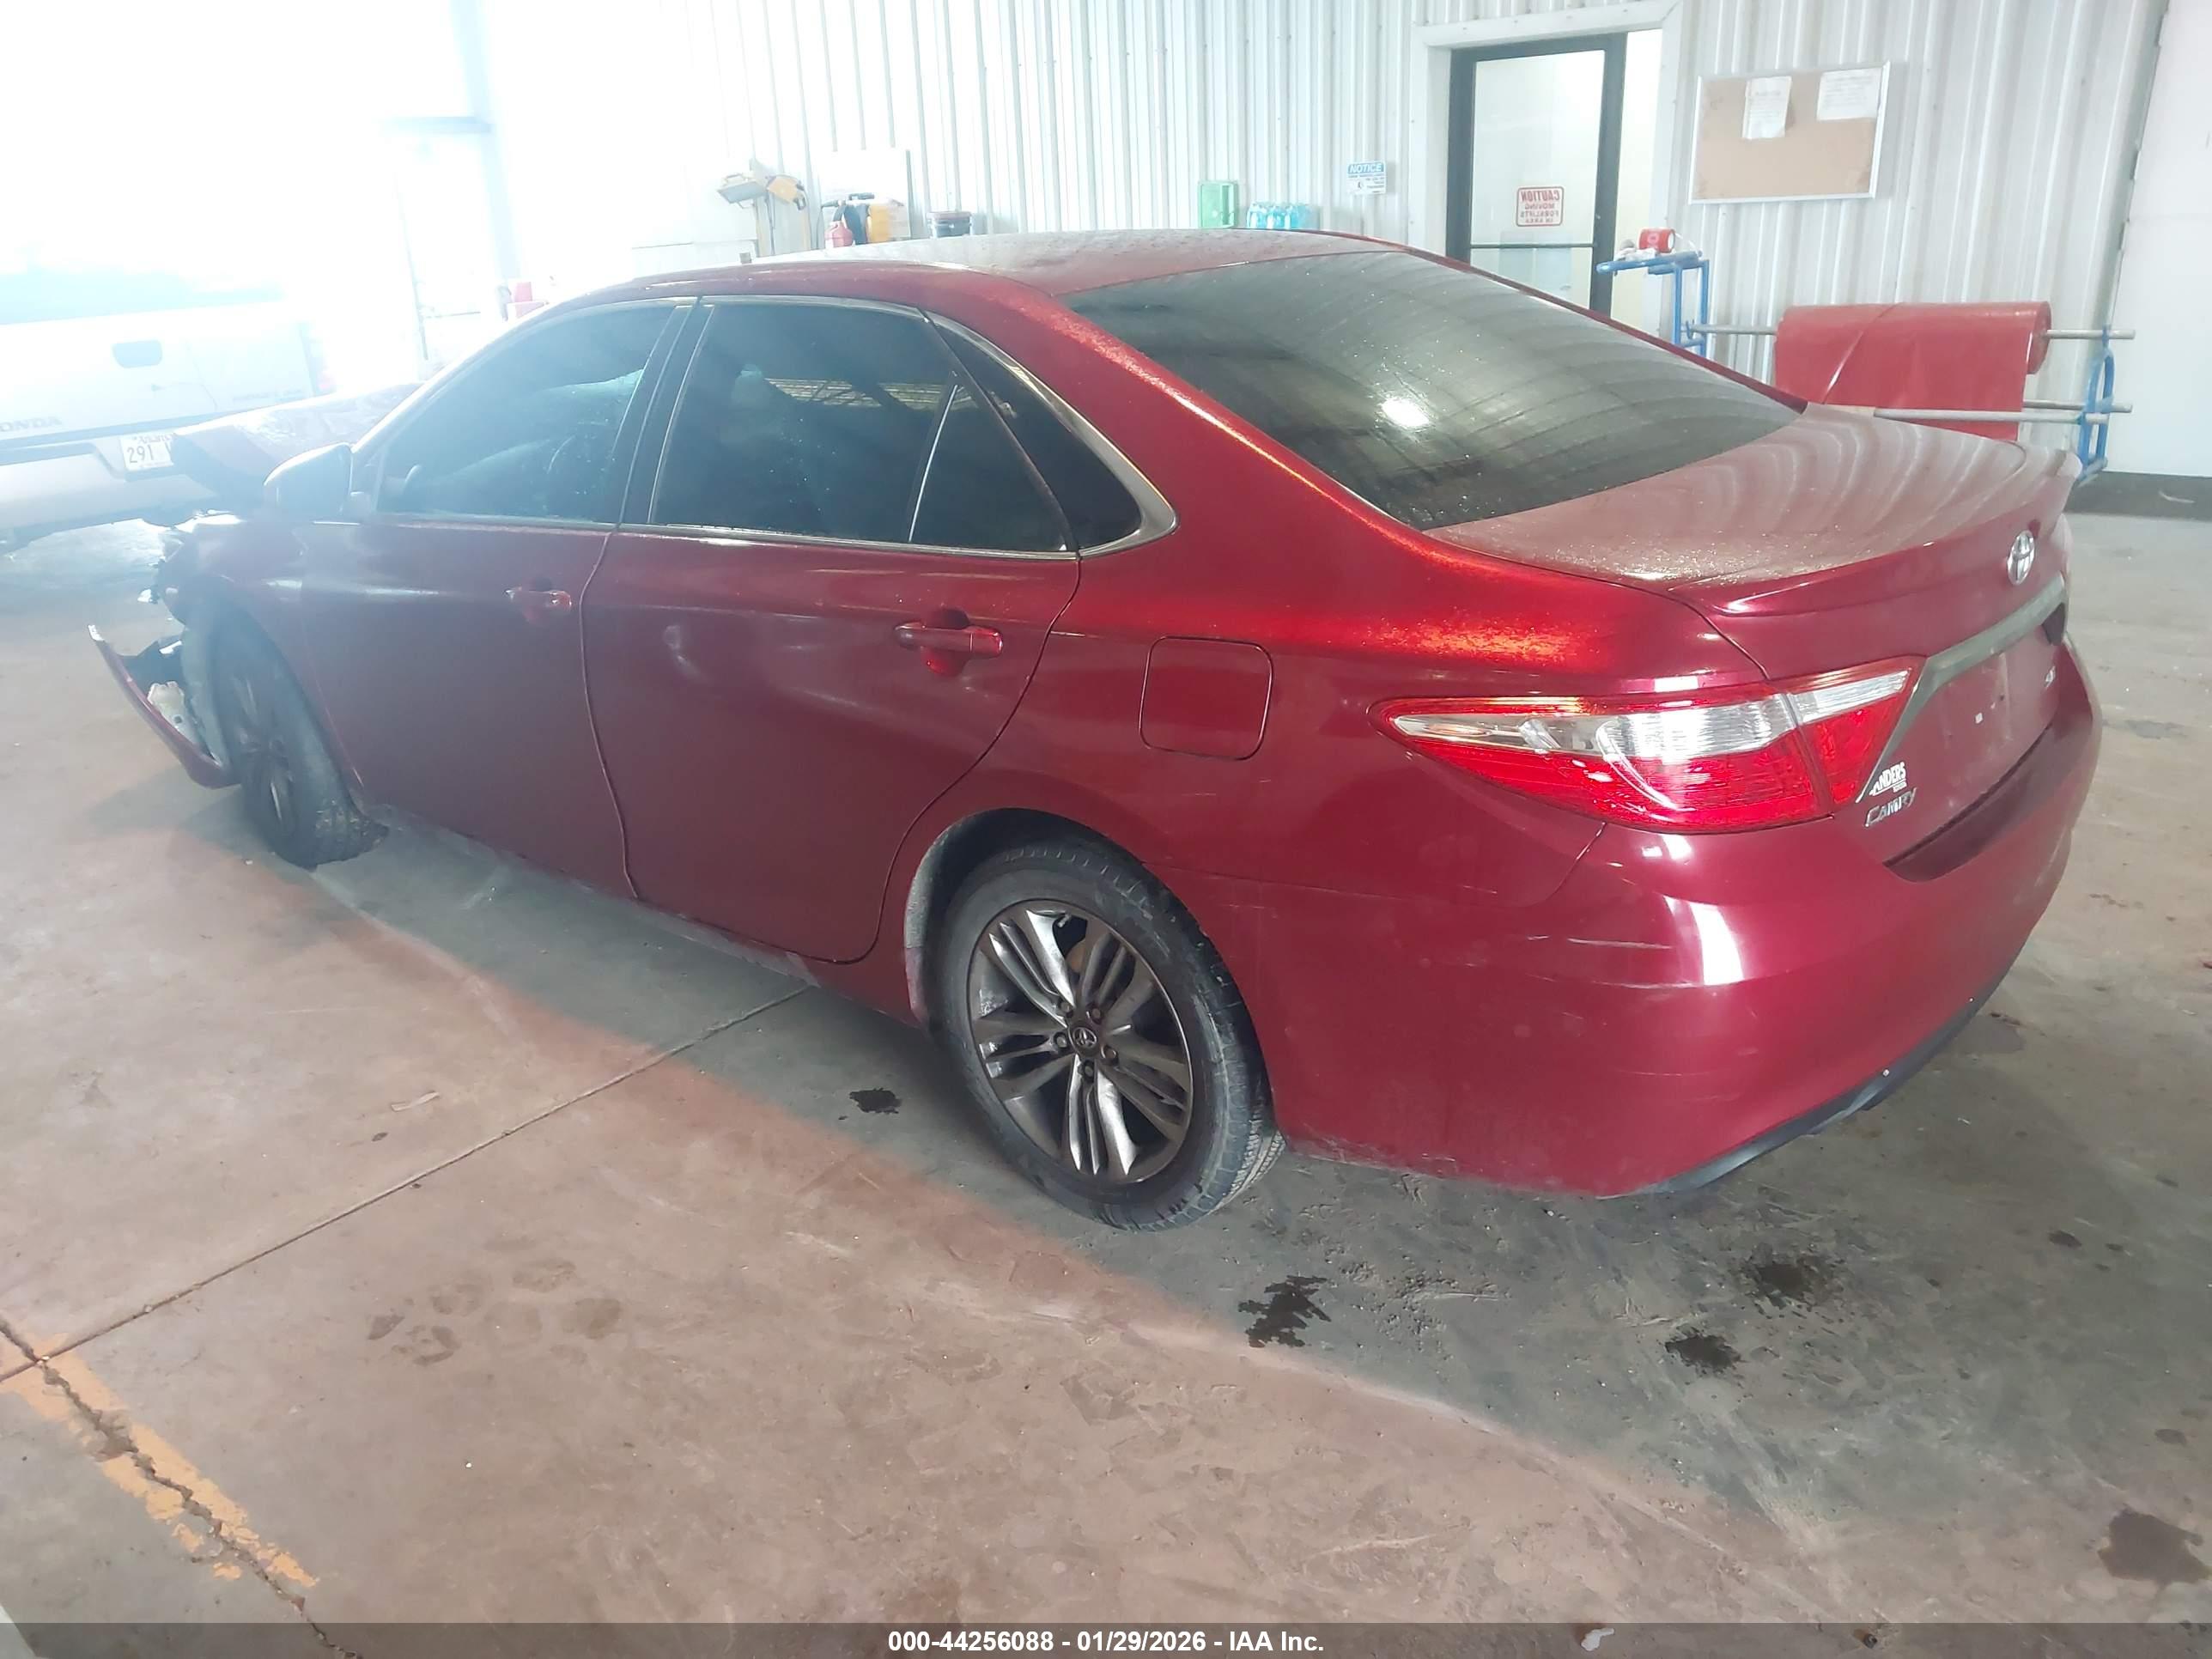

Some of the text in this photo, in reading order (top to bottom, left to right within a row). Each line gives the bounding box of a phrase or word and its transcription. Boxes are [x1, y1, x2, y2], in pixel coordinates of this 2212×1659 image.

[1349, 163, 1382, 173] NOTICE
[0, 416, 63, 432] ONDA
[126, 444, 155, 464] 291
[1865, 787, 1917, 827] CAMRY
